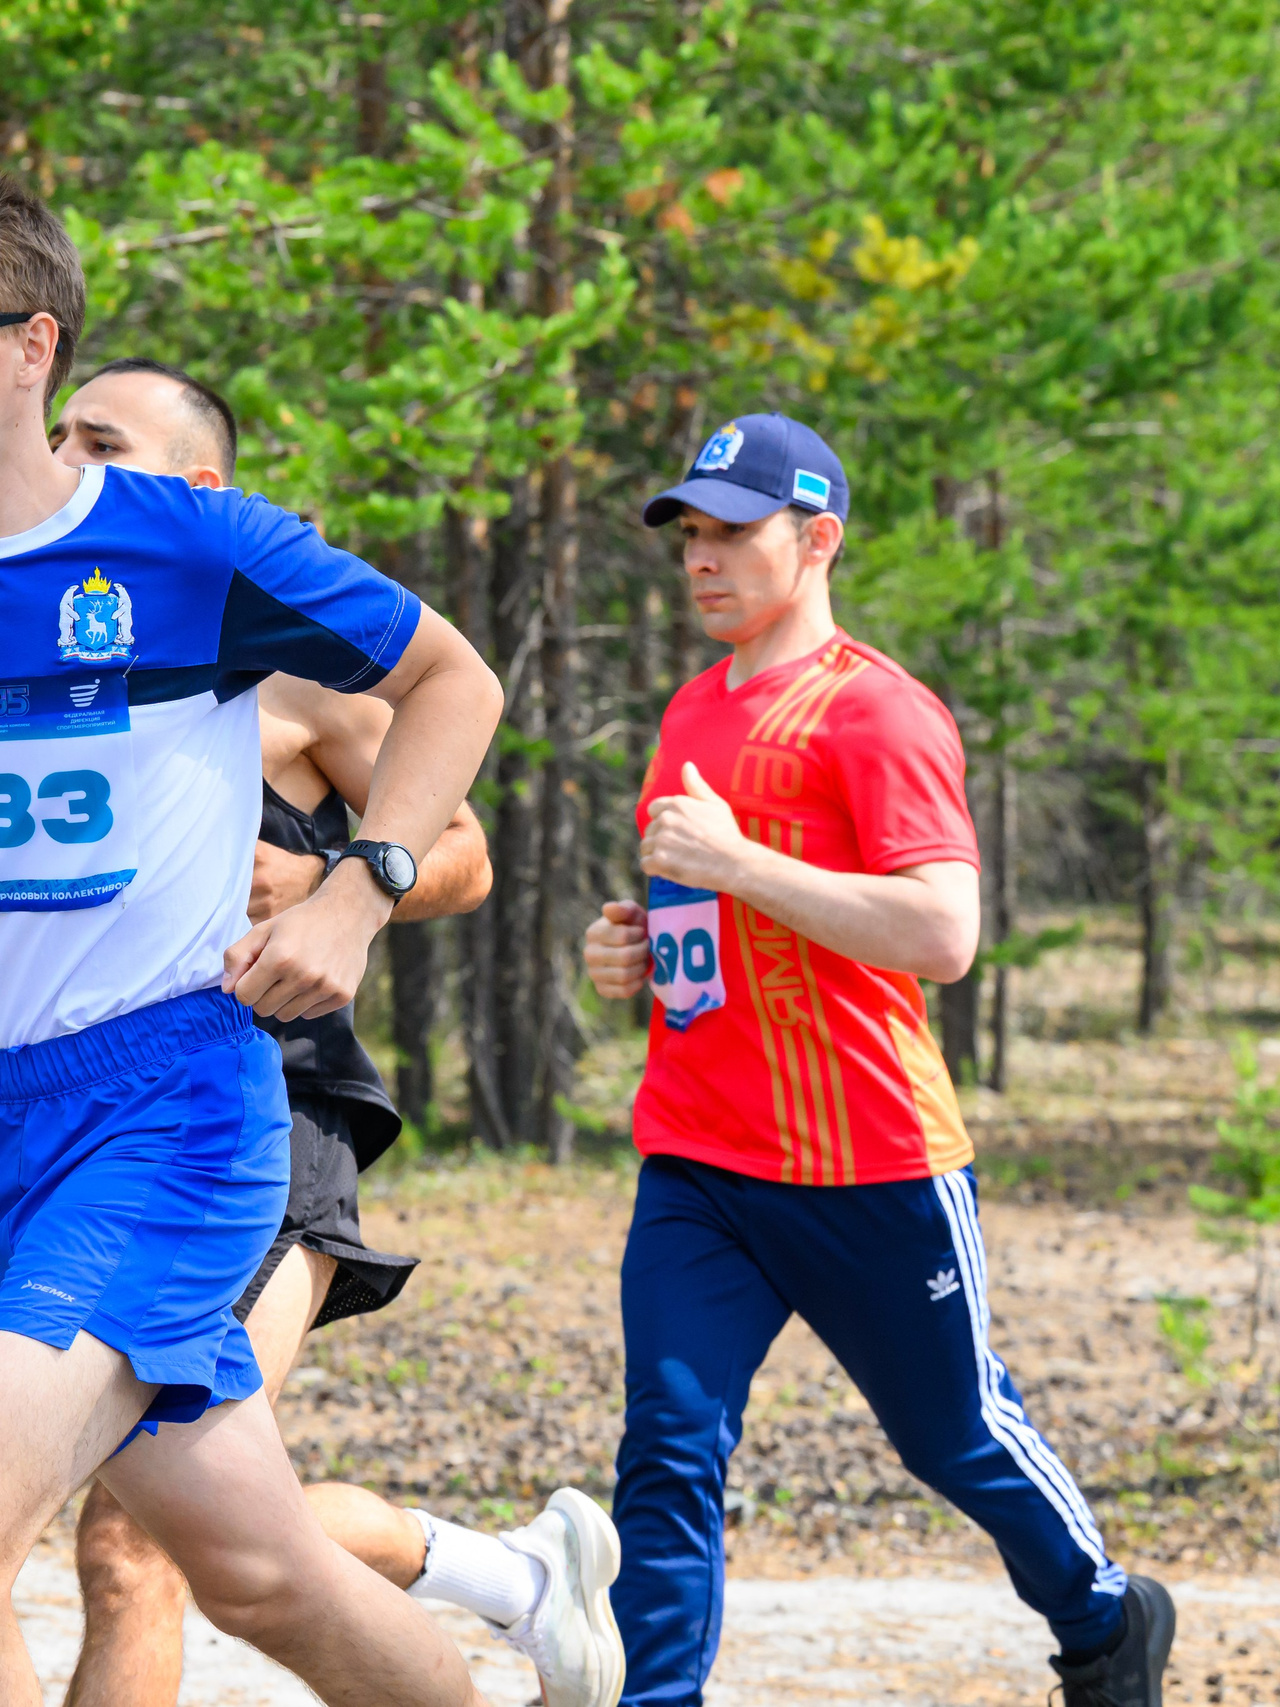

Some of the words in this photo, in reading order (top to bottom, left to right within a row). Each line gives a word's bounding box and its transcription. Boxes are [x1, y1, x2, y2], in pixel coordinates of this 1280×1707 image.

[63, 710, 105, 719] ФЕДЕРАЛЬНАЯ
[70, 716, 101, 724] ДИРЕКЦИЯ
[56, 720, 116, 731] СПОРТМЕРОПРИЯТИЙ
[649, 928, 716, 986] 90
[746, 901, 813, 1026] ЯМА
[31, 1283, 75, 1303] DEMIX
